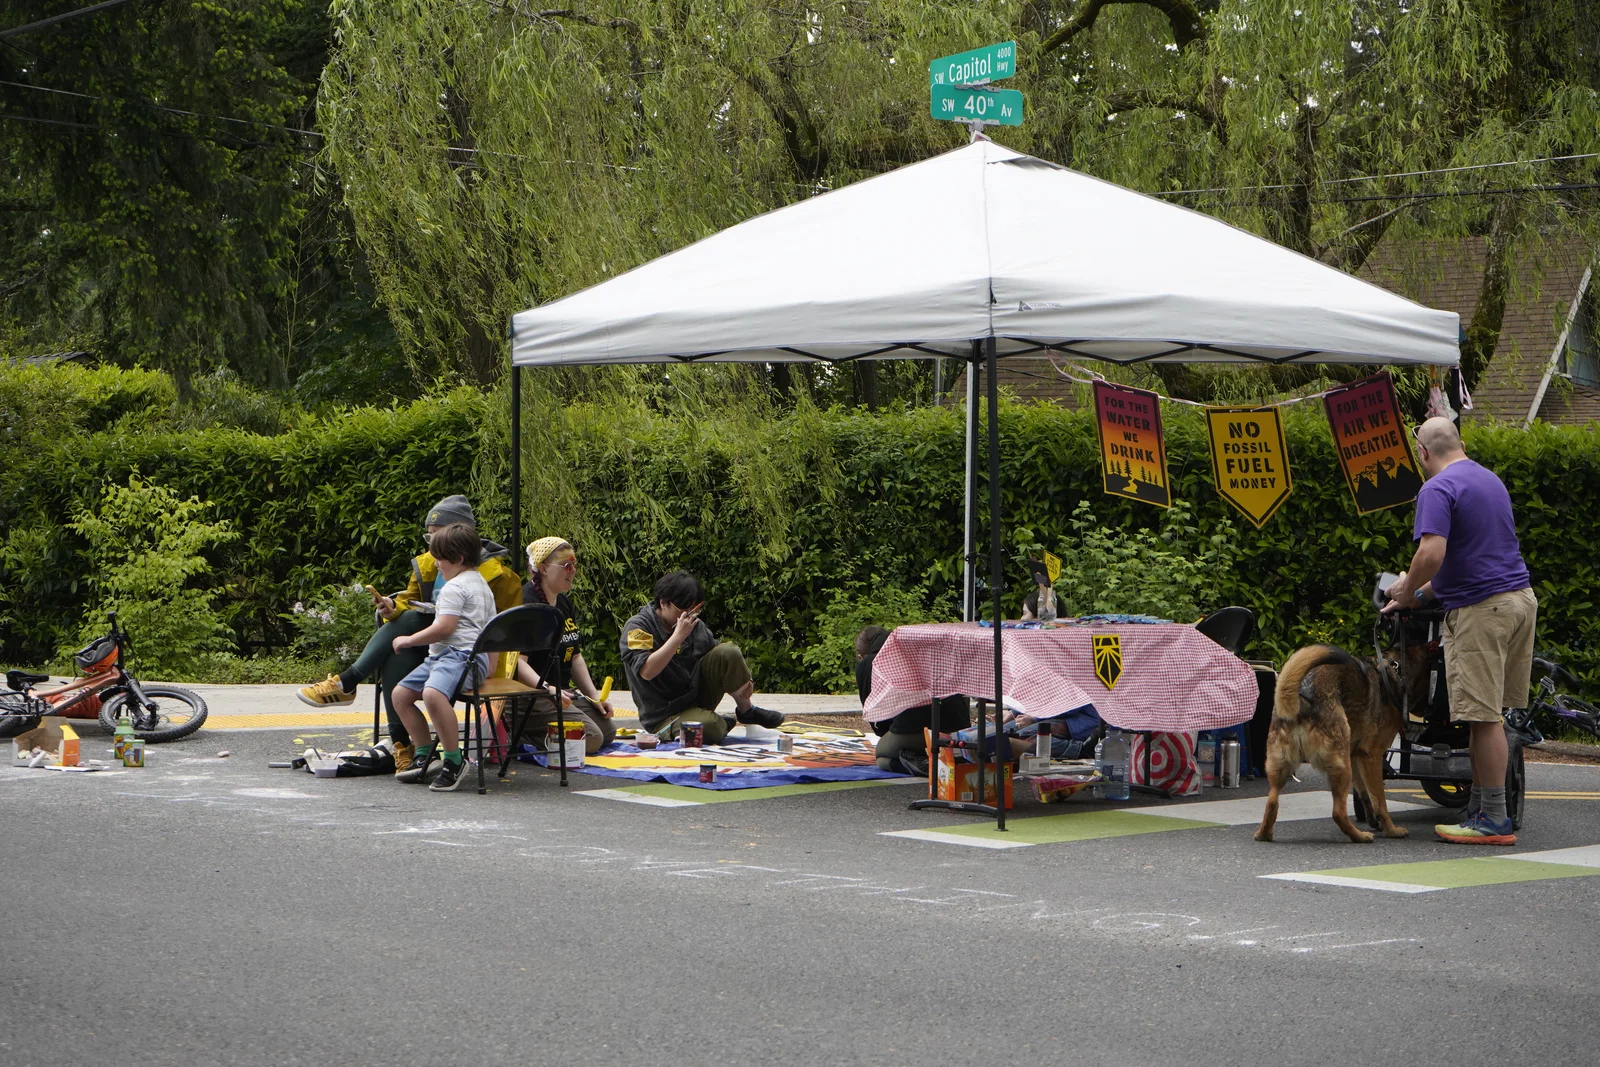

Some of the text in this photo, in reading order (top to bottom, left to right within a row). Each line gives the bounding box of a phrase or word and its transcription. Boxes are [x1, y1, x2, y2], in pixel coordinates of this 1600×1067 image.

[997, 47, 1011, 59] 4000
[934, 53, 1008, 84] SW Capitol Hwy
[941, 95, 1012, 117] SW 40th Av
[1104, 396, 1148, 414] FOR THE
[1337, 390, 1384, 416] FOR THE
[1106, 411, 1150, 431] WATER
[1228, 421, 1260, 439] NO
[1343, 409, 1389, 438] AIR WE
[1123, 431, 1139, 443] WE
[1343, 430, 1399, 460] BREATHE
[1110, 442, 1155, 463] DRINK
[1223, 441, 1272, 454] FOSSIL
[1226, 457, 1274, 474] FUEL
[1230, 477, 1276, 489] MONEY
